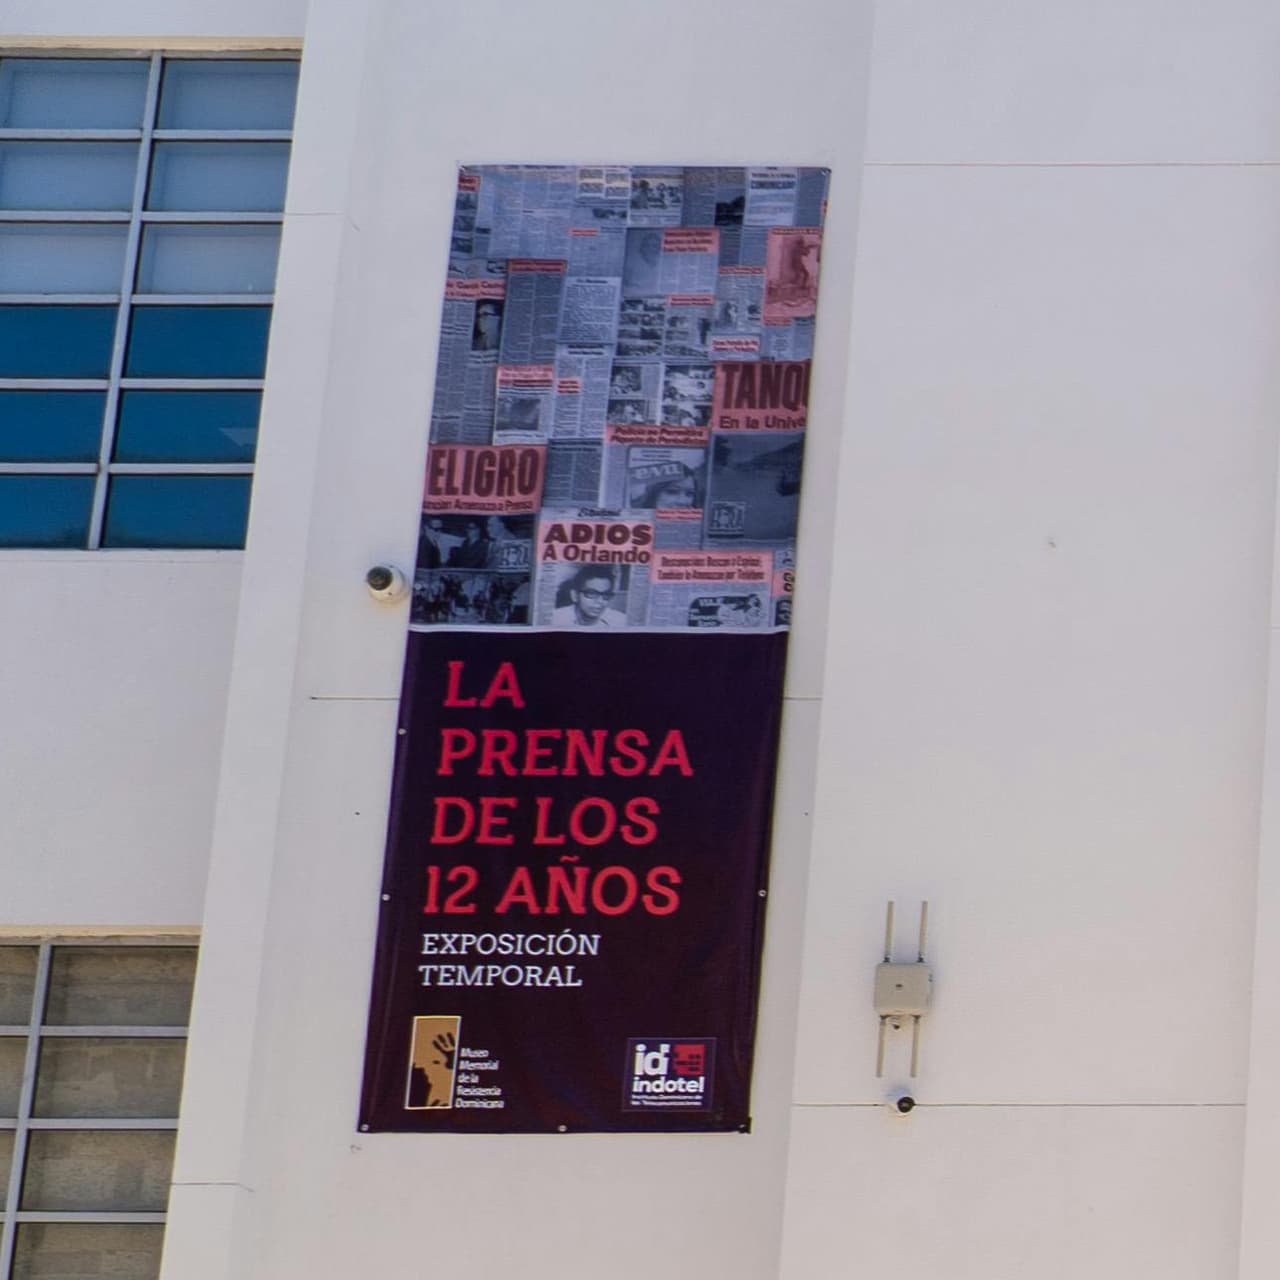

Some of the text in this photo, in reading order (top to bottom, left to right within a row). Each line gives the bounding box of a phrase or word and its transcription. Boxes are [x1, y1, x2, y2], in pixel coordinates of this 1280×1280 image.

[719, 416, 739, 429] En
[746, 416, 759, 429] la
[428, 449, 541, 497] ELIGRO
[544, 523, 652, 545] ADIOS
[543, 544, 650, 564] A Orlando
[443, 661, 525, 708] LA
[437, 729, 694, 777] PRENSA
[430, 797, 660, 846] DE LOS
[423, 855, 681, 915] 12 AÑOS
[421, 929, 600, 956] EXPOSICIÓN
[418, 965, 583, 987] TEMPORAL
[632, 1076, 704, 1093] indotel
